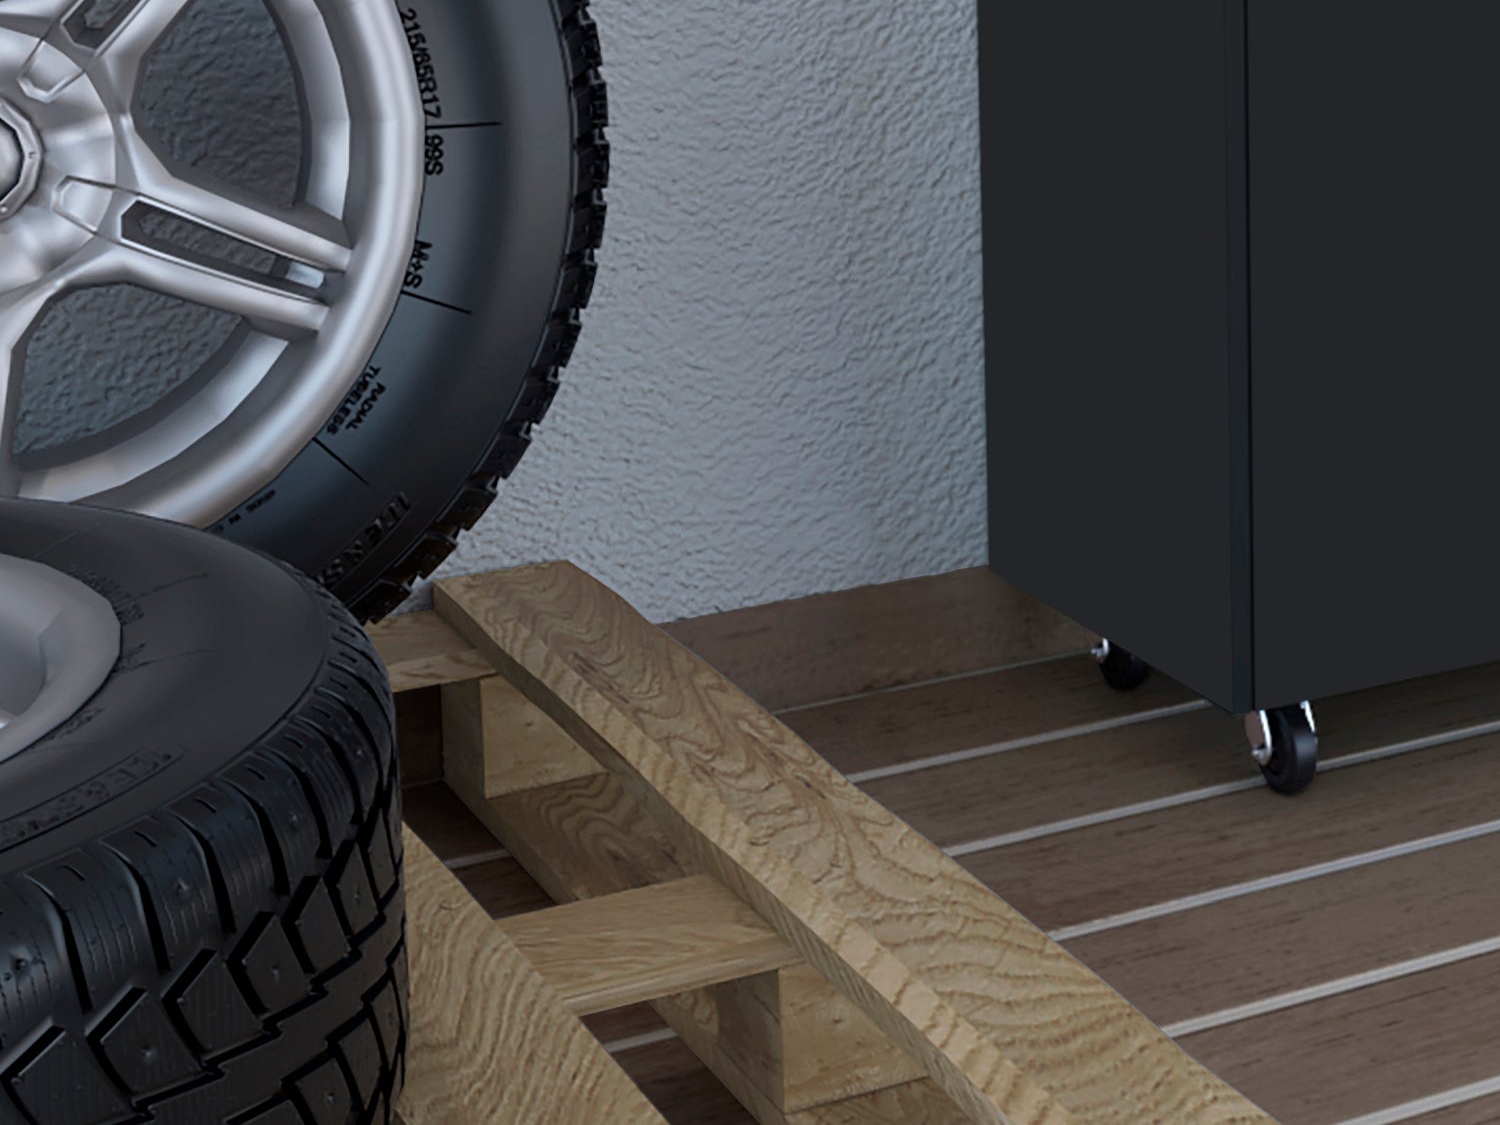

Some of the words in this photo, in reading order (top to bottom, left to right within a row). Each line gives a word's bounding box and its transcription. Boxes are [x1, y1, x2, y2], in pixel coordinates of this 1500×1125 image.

[424, 134, 444, 176] 99S
[404, 239, 433, 289] M+S
[346, 382, 386, 430] RADIAL
